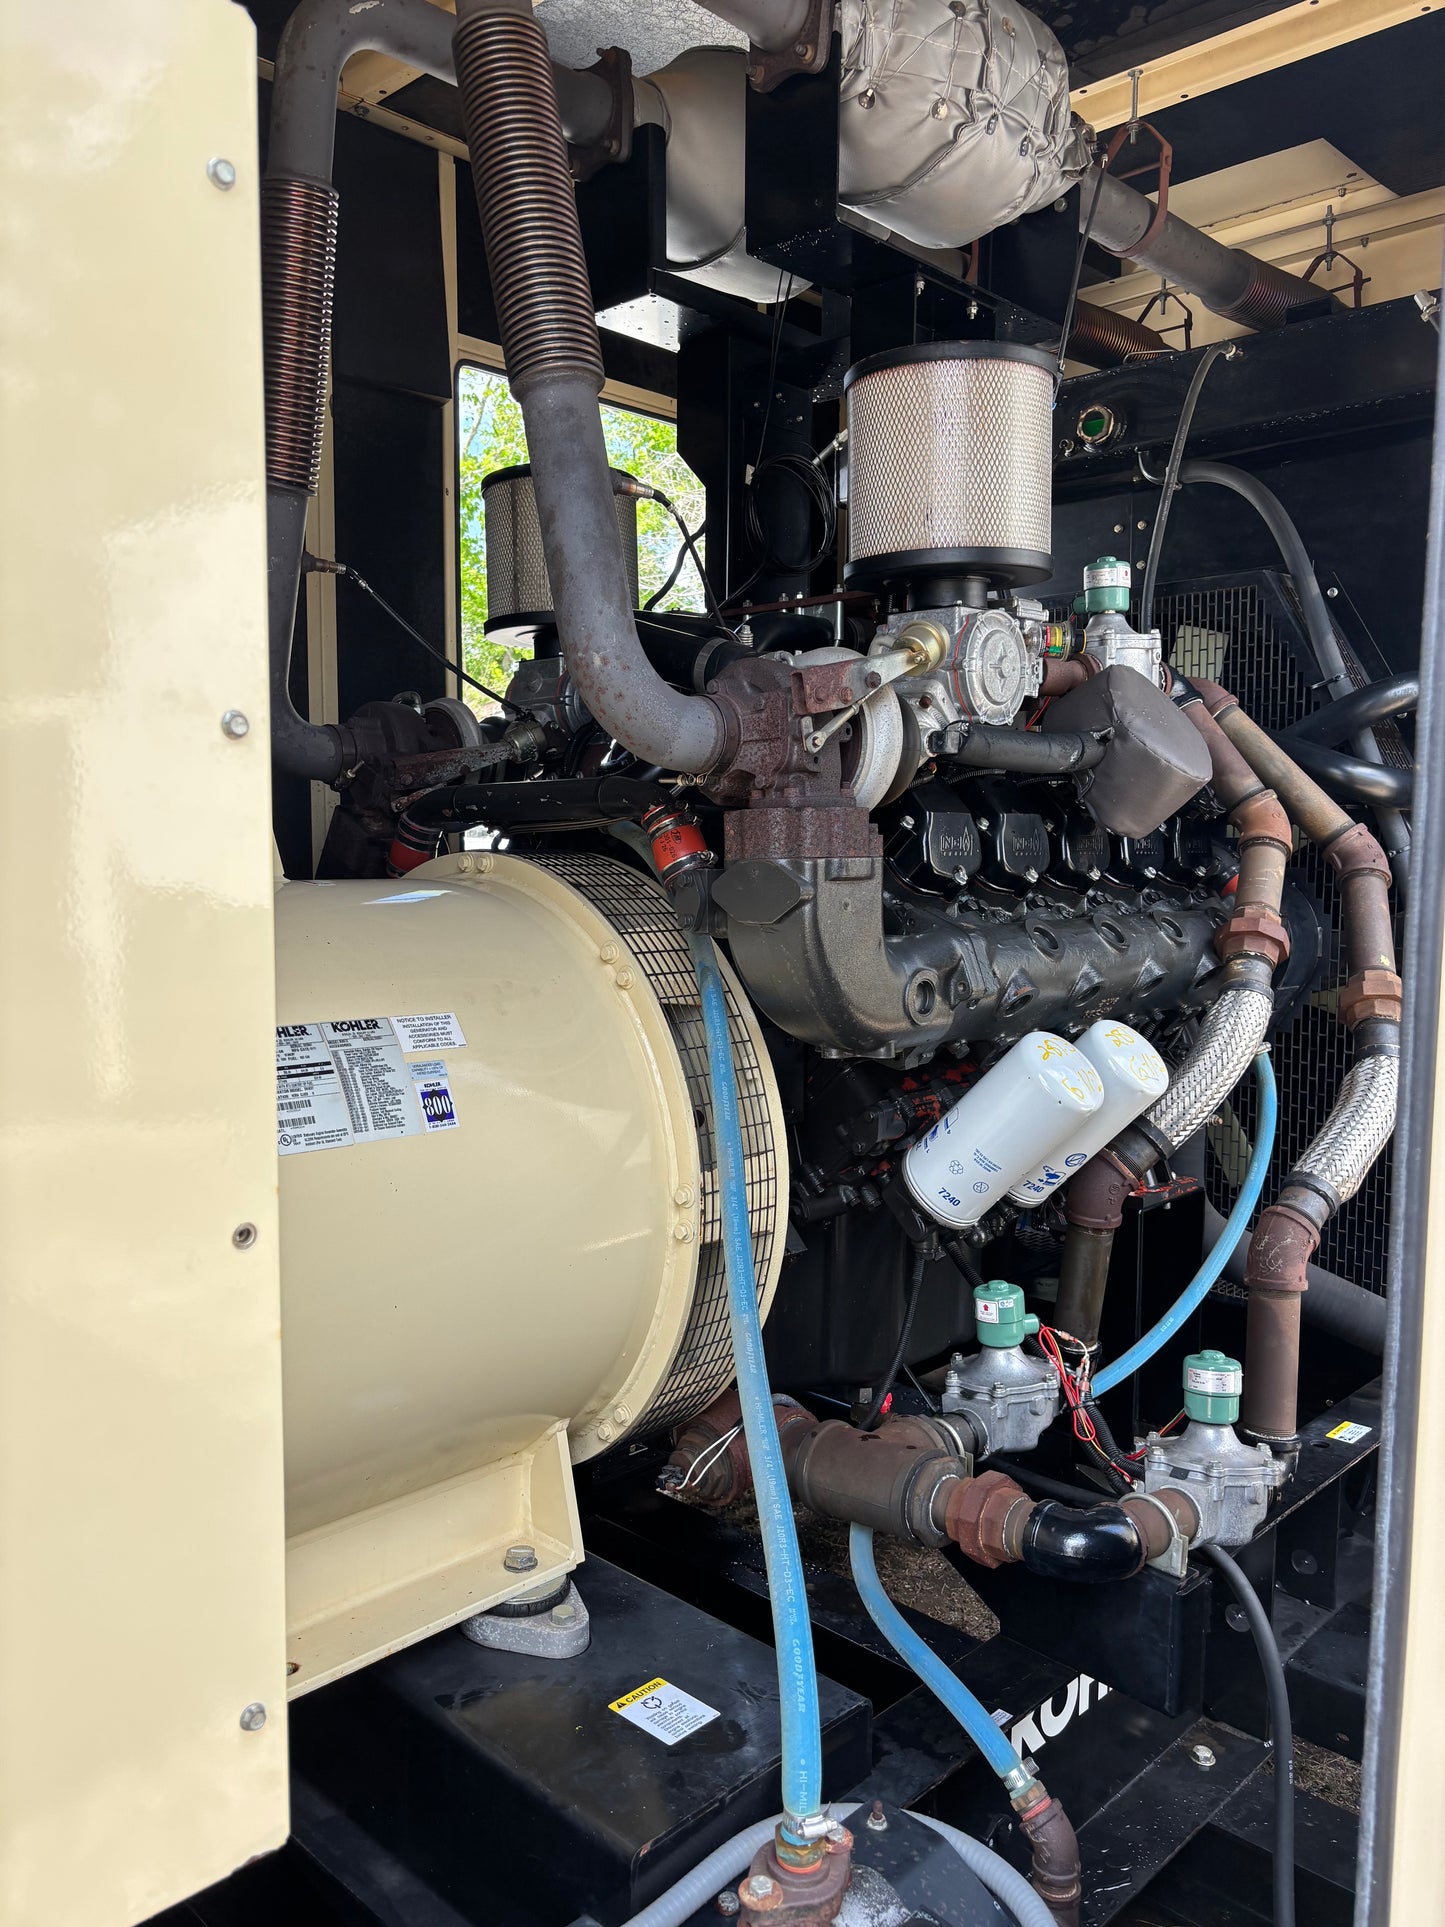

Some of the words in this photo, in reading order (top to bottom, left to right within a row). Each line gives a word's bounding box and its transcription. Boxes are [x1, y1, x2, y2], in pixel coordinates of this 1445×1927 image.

[331, 1019, 380, 1033] KOHLER
[424, 1094, 451, 1116] 800
[938, 1187, 961, 1207] 7240
[1022, 1180, 1045, 1193] 7240
[744, 1332, 757, 1375] GOODYEAR
[772, 1503, 784, 1521] SAE
[791, 1638, 807, 1713] GOODYEAR
[625, 1681, 662, 1703] CAUTION
